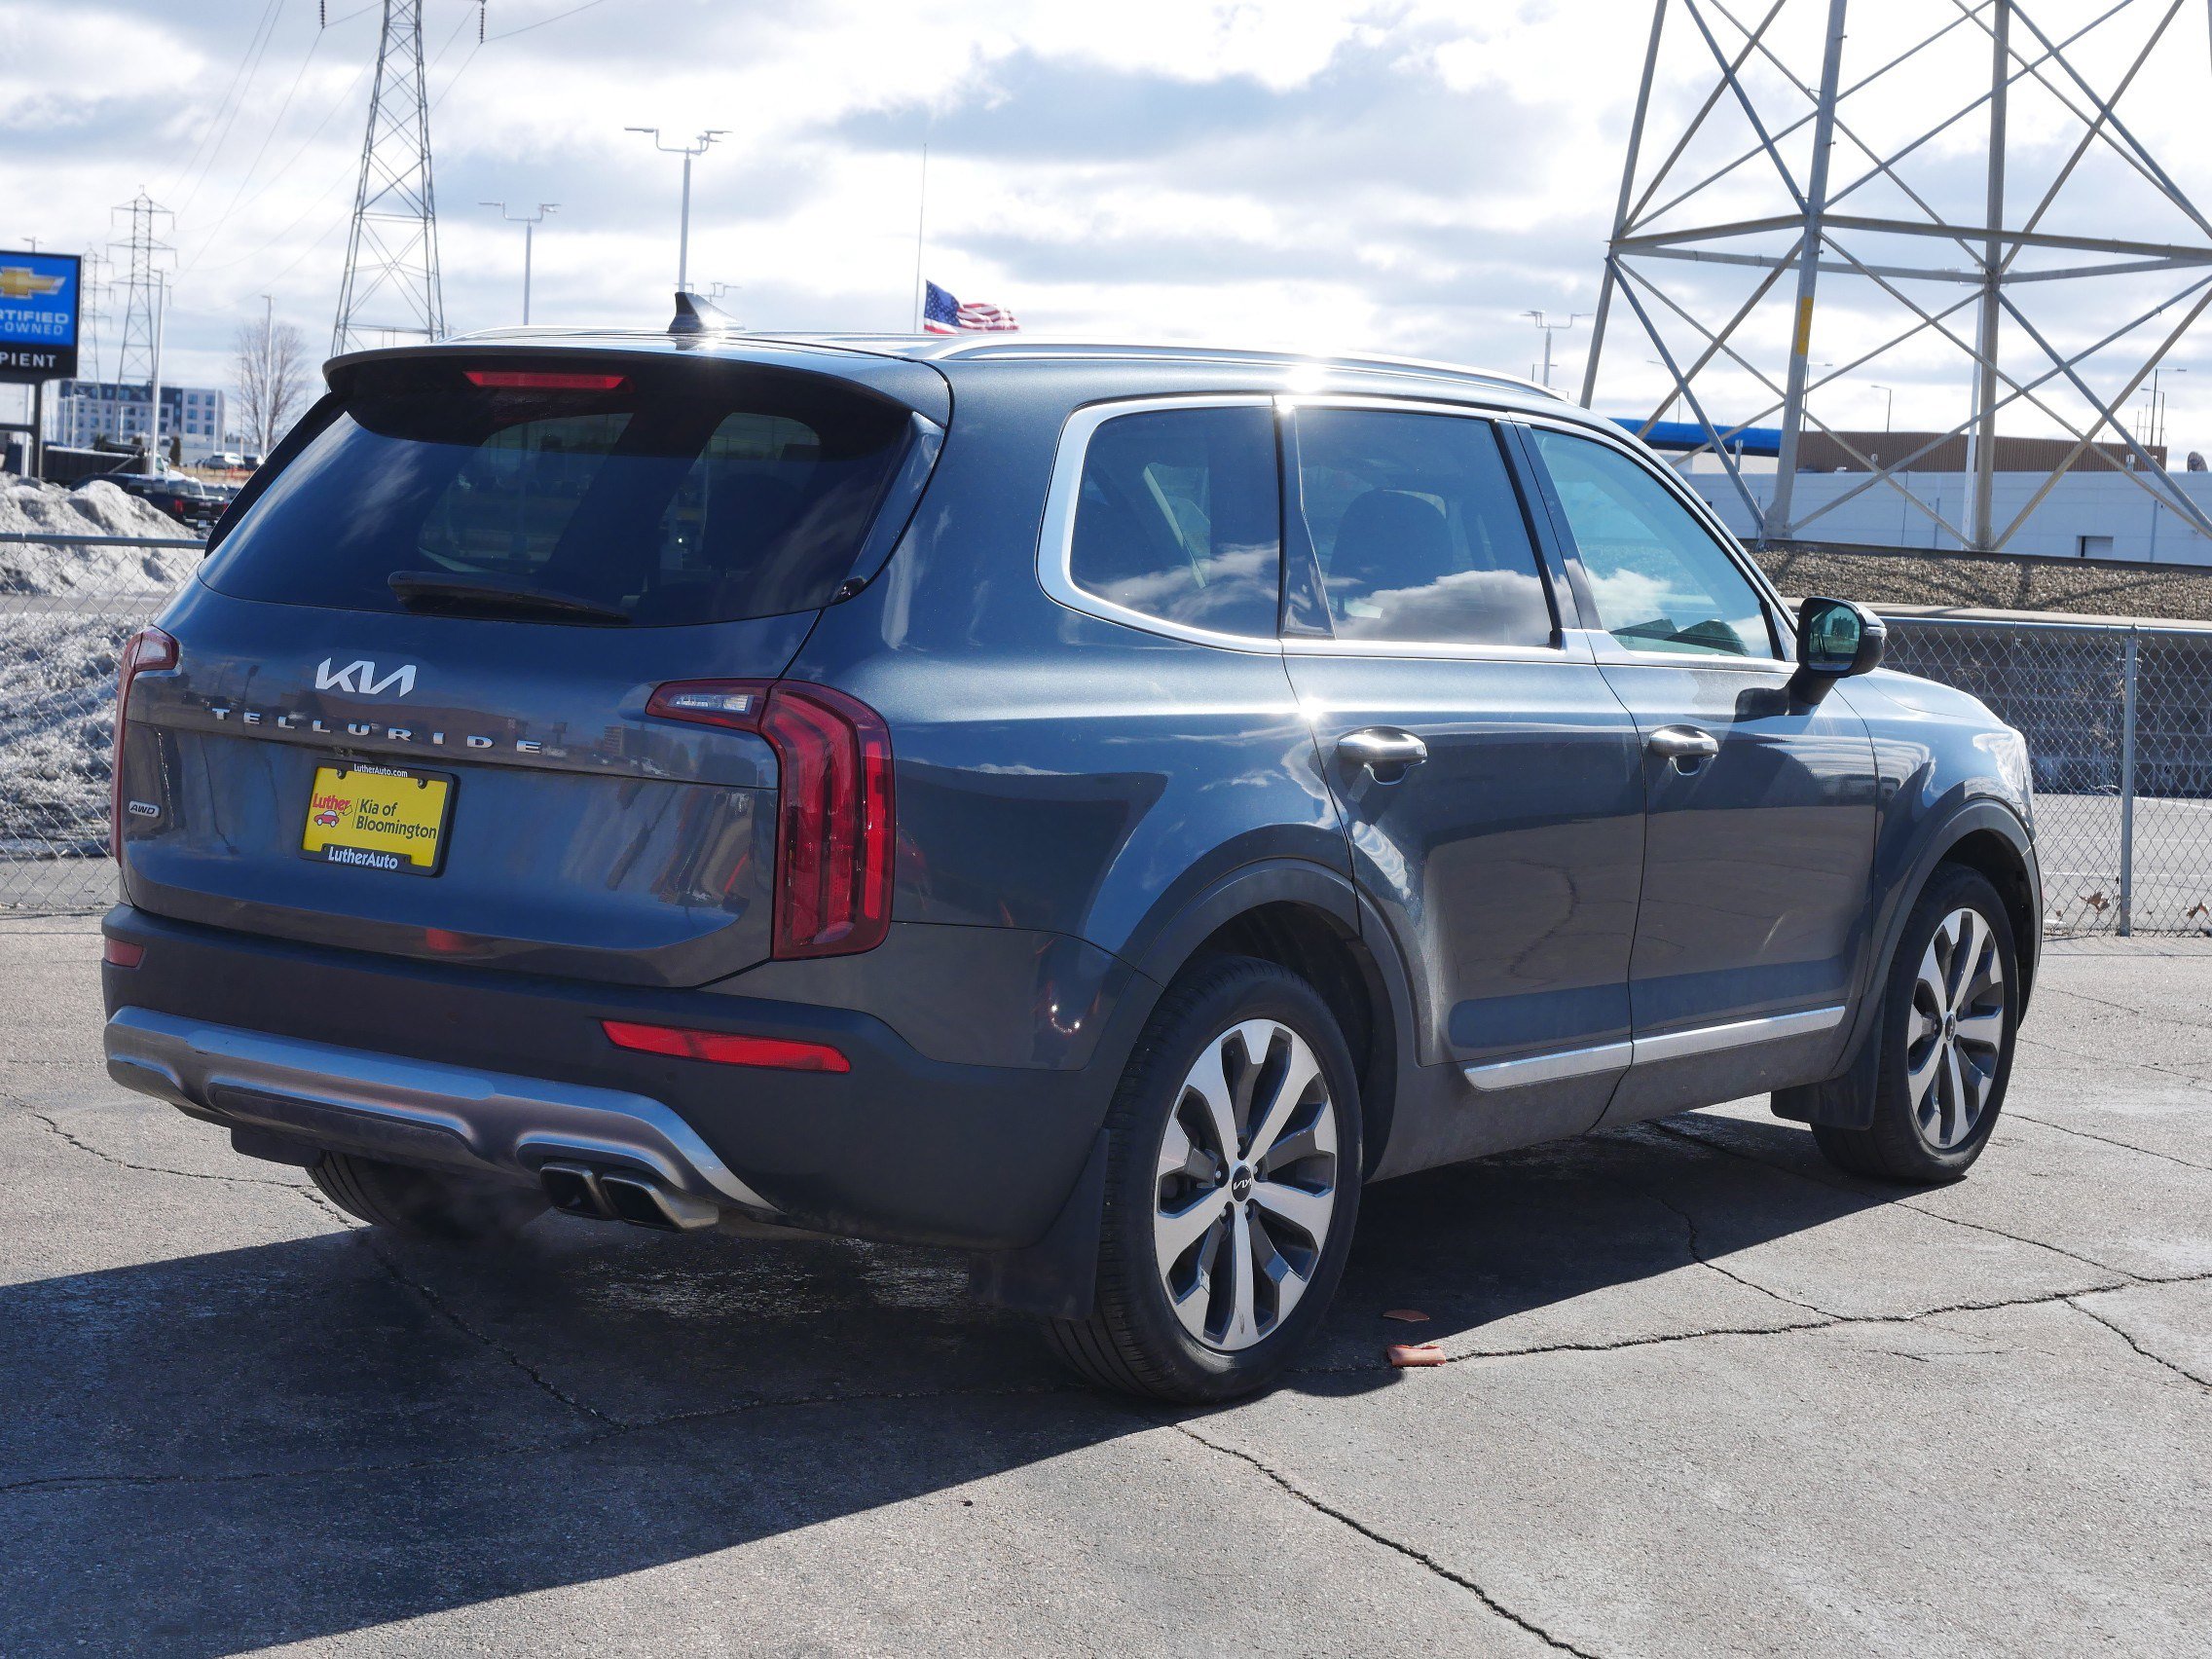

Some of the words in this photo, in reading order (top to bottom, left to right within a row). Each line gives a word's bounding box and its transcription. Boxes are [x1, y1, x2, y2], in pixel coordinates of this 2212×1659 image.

[0, 309, 69, 324] TIFIED
[211, 707, 542, 755] TELLURIDE
[353, 763, 408, 778] LutherAuto.com
[129, 804, 156, 815] AWD
[312, 793, 351, 811] Luther
[359, 798, 380, 815] Kia
[382, 801, 398, 817] of
[355, 815, 437, 839] Bloomington
[328, 846, 398, 869] LutherAuto
